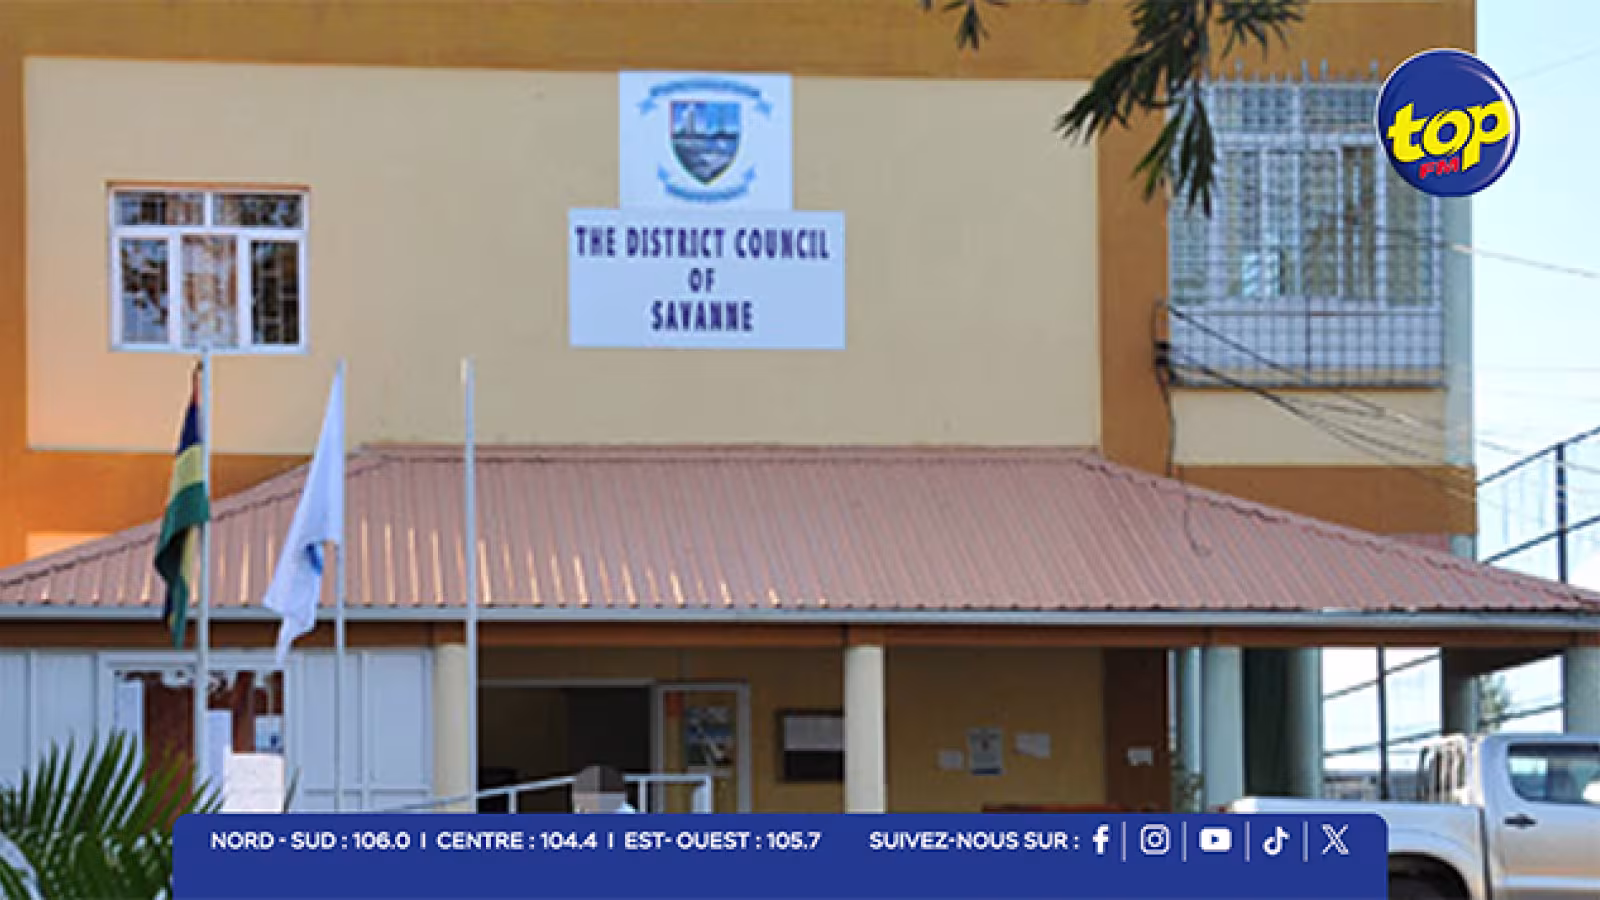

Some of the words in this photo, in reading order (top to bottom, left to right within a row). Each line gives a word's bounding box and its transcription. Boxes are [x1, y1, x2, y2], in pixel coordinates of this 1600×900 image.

[575, 226, 616, 257] THE
[627, 227, 725, 258] DISTRICT
[735, 229, 829, 259] COUNCIL
[688, 267, 715, 293] OF
[652, 300, 753, 332] SAVANNE
